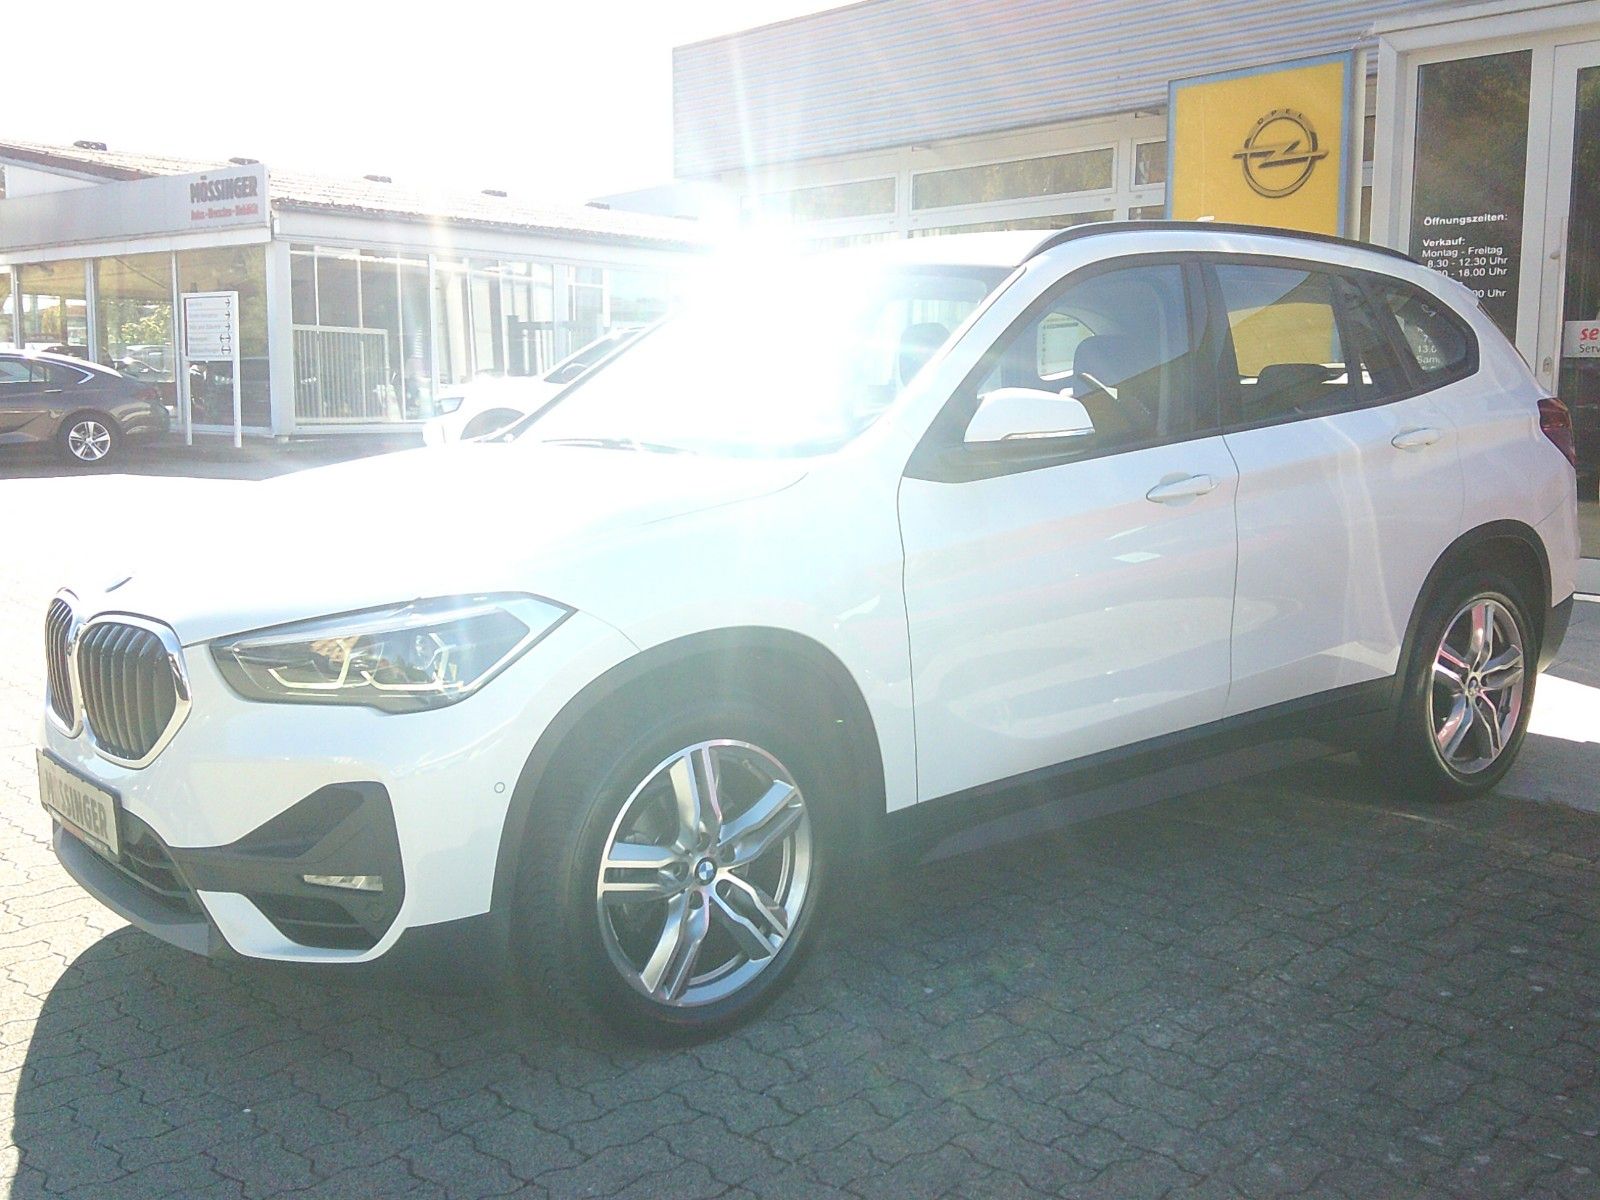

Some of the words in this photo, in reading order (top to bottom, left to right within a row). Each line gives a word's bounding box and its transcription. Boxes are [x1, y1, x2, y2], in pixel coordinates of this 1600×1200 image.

[1257, 108, 1304, 125] OPEL
[189, 175, 258, 203] MÖSSINGER
[1423, 213, 1508, 226] Öffnungszeiten:
[1422, 236, 1466, 247] Verkauf:
[1421, 249, 1459, 258] Montag
[1468, 246, 1503, 256] Freitag
[1427, 259, 1449, 268] 8.30
[1459, 257, 1487, 267] 12.30
[1489, 256, 1508, 265] Uhr
[1459, 268, 1486, 277] 18.00
[1488, 267, 1508, 276] Uhr
[1487, 288, 1507, 298] Uhr
[44, 767, 109, 842] MSSINGER
